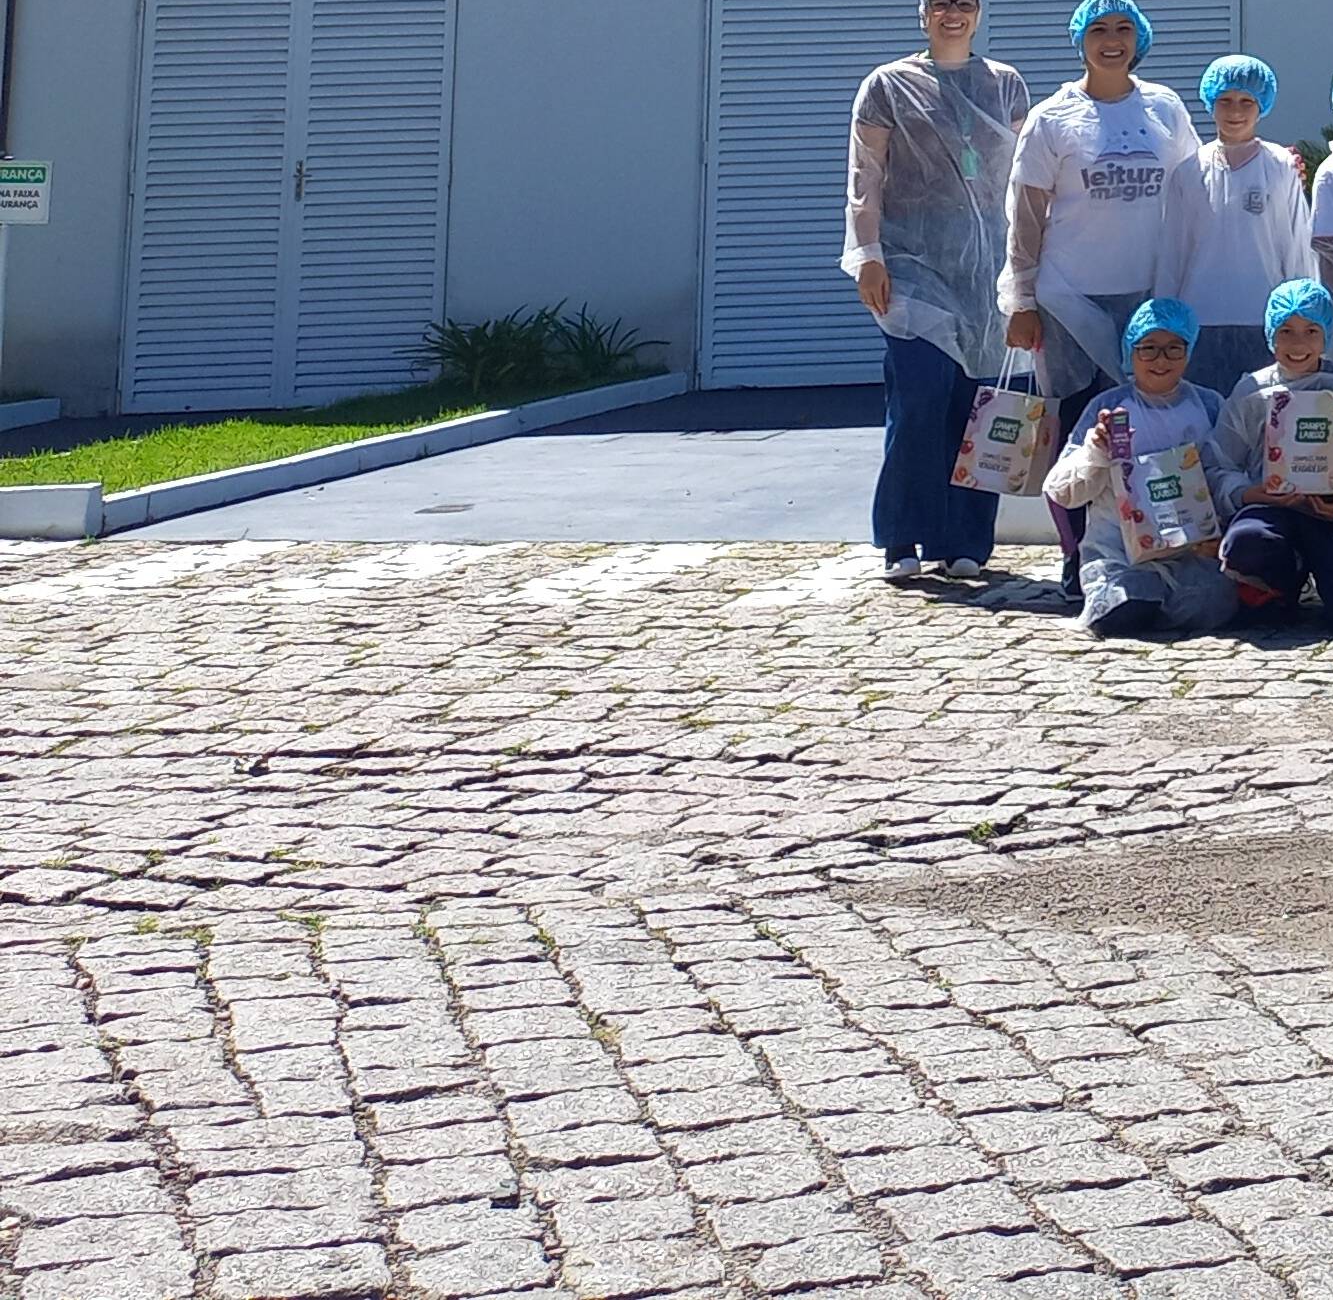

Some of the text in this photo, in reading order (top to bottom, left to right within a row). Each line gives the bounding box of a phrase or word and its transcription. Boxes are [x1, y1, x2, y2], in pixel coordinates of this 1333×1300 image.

[0, 169, 44, 182] RANÇA
[1081, 163, 1165, 190] leitura
[0, 200, 39, 211] URANÇA
